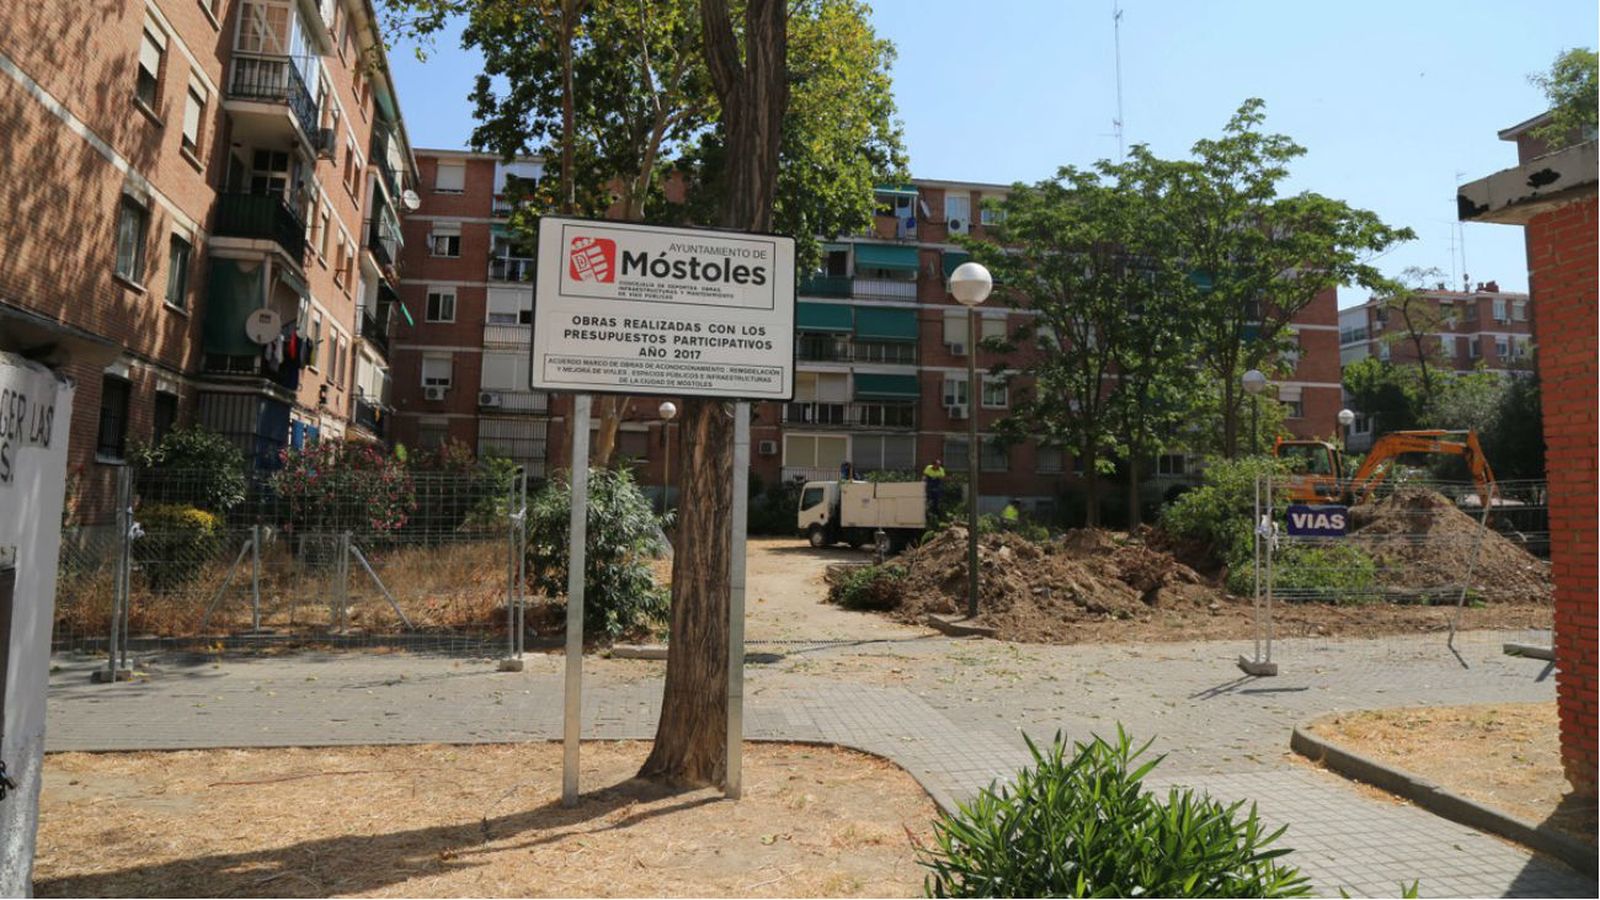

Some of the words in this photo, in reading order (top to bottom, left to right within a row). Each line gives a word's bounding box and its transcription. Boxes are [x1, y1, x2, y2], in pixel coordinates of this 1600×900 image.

[668, 242, 750, 258] AYUNTAMIENTO
[752, 250, 768, 260] DE
[621, 250, 767, 286] Móstoles
[571, 315, 617, 328] OBRAS
[624, 319, 702, 333] REALIZADAS
[708, 323, 736, 335] CON
[741, 325, 767, 337] LOS
[564, 329, 668, 345] PRESUPUESTOS
[673, 335, 773, 350] PARTICIPATIVOS
[638, 345, 668, 359] AÑO
[674, 347, 702, 360] 2017
[548, 357, 582, 365] ACUERDO
[583, 359, 609, 367] MARCO
[706, 374, 772, 383] INFRAESTRUCTURAS
[29, 402, 54, 447] LAS
[1292, 513, 1345, 529] VIAS
